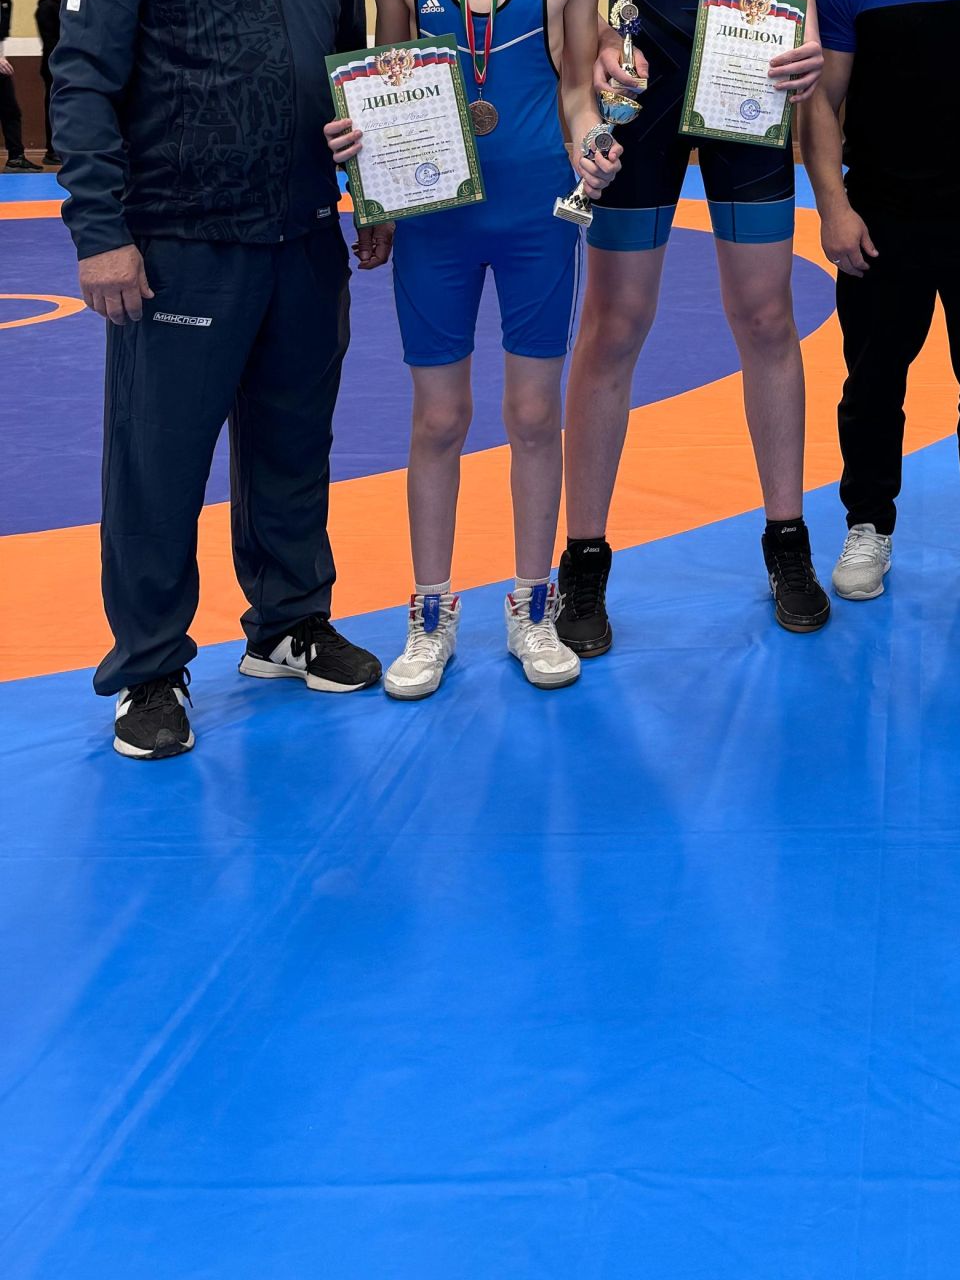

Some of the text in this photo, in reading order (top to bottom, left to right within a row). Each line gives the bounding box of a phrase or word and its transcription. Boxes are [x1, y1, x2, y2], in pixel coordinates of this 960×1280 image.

[421, 6, 445, 14] adidas
[717, 24, 783, 45] ДИПЛОМ
[361, 84, 441, 112] ДИПЛОМ
